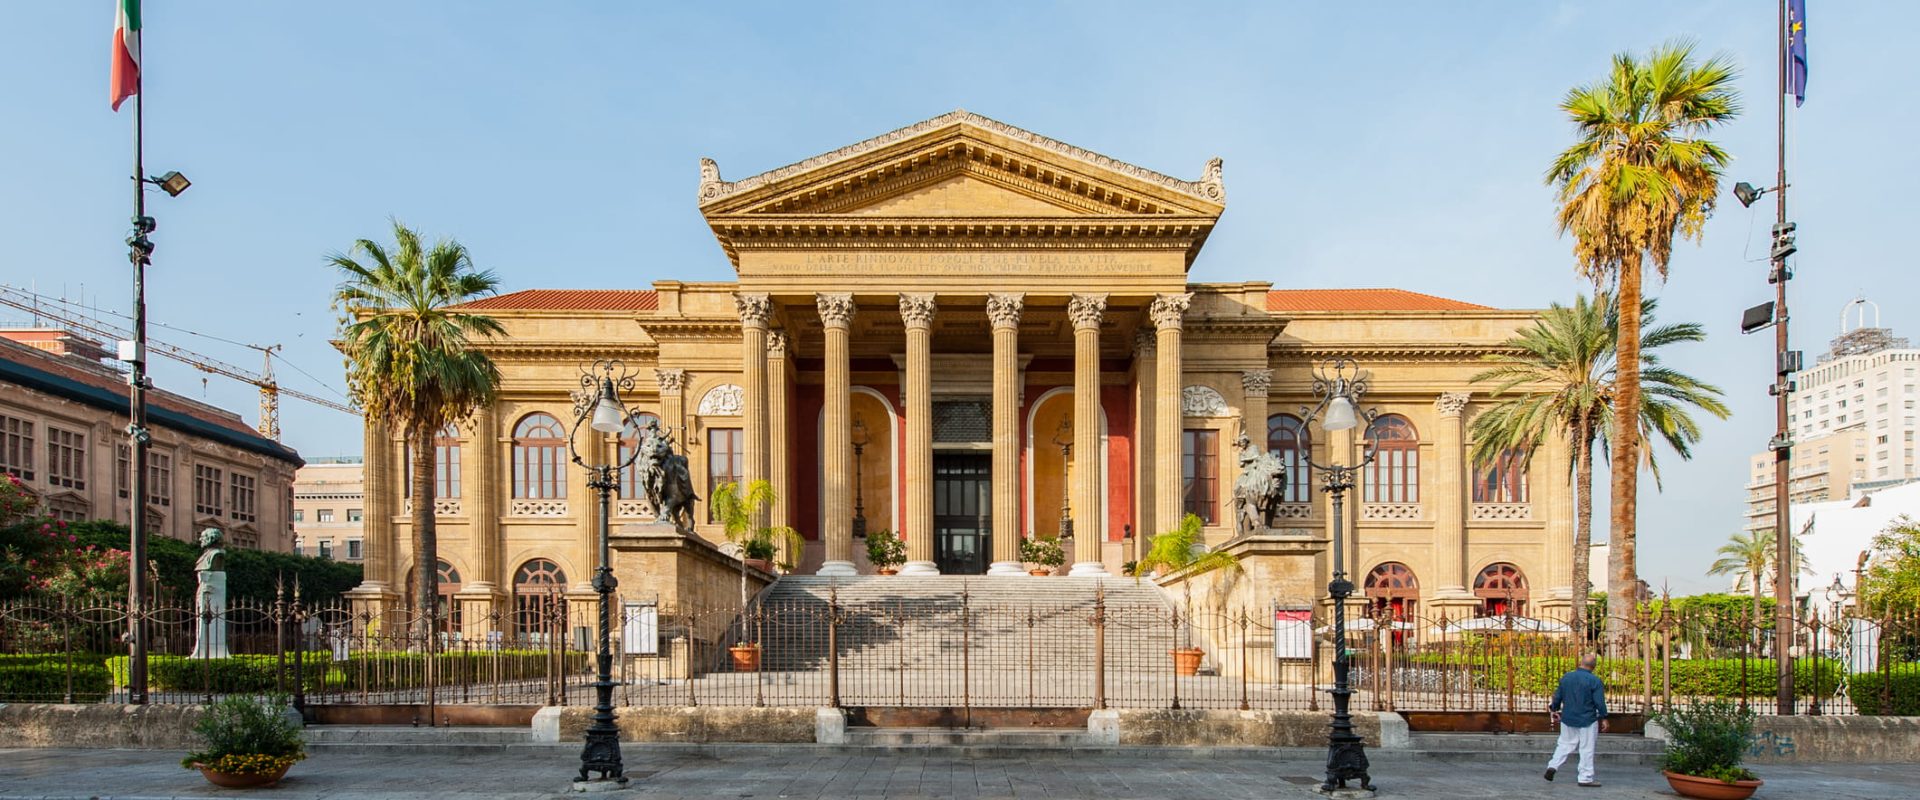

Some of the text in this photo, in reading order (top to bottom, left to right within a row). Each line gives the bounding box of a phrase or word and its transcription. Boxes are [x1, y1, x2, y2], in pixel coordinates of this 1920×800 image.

[807, 254, 849, 264] L'ARTE
[856, 254, 913, 264] RINNOVA
[931, 254, 973, 264] POPOLI
[1016, 254, 1061, 264] RIVELA
[1068, 254, 1082, 264] LA
